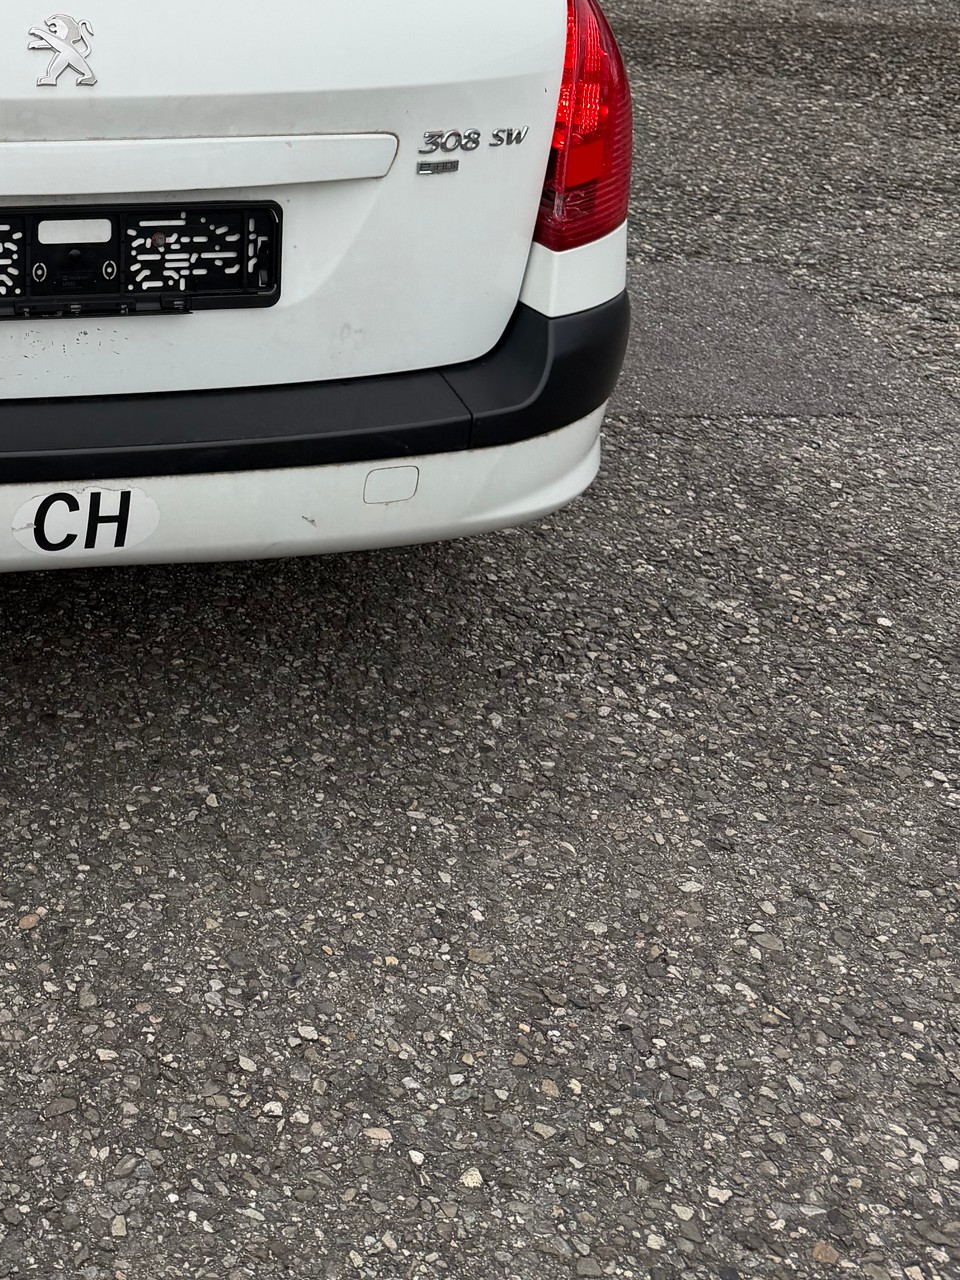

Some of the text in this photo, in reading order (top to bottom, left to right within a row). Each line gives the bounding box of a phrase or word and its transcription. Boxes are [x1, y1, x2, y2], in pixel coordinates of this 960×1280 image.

[418, 126, 529, 154] 308 SW
[33, 490, 132, 552] CH
